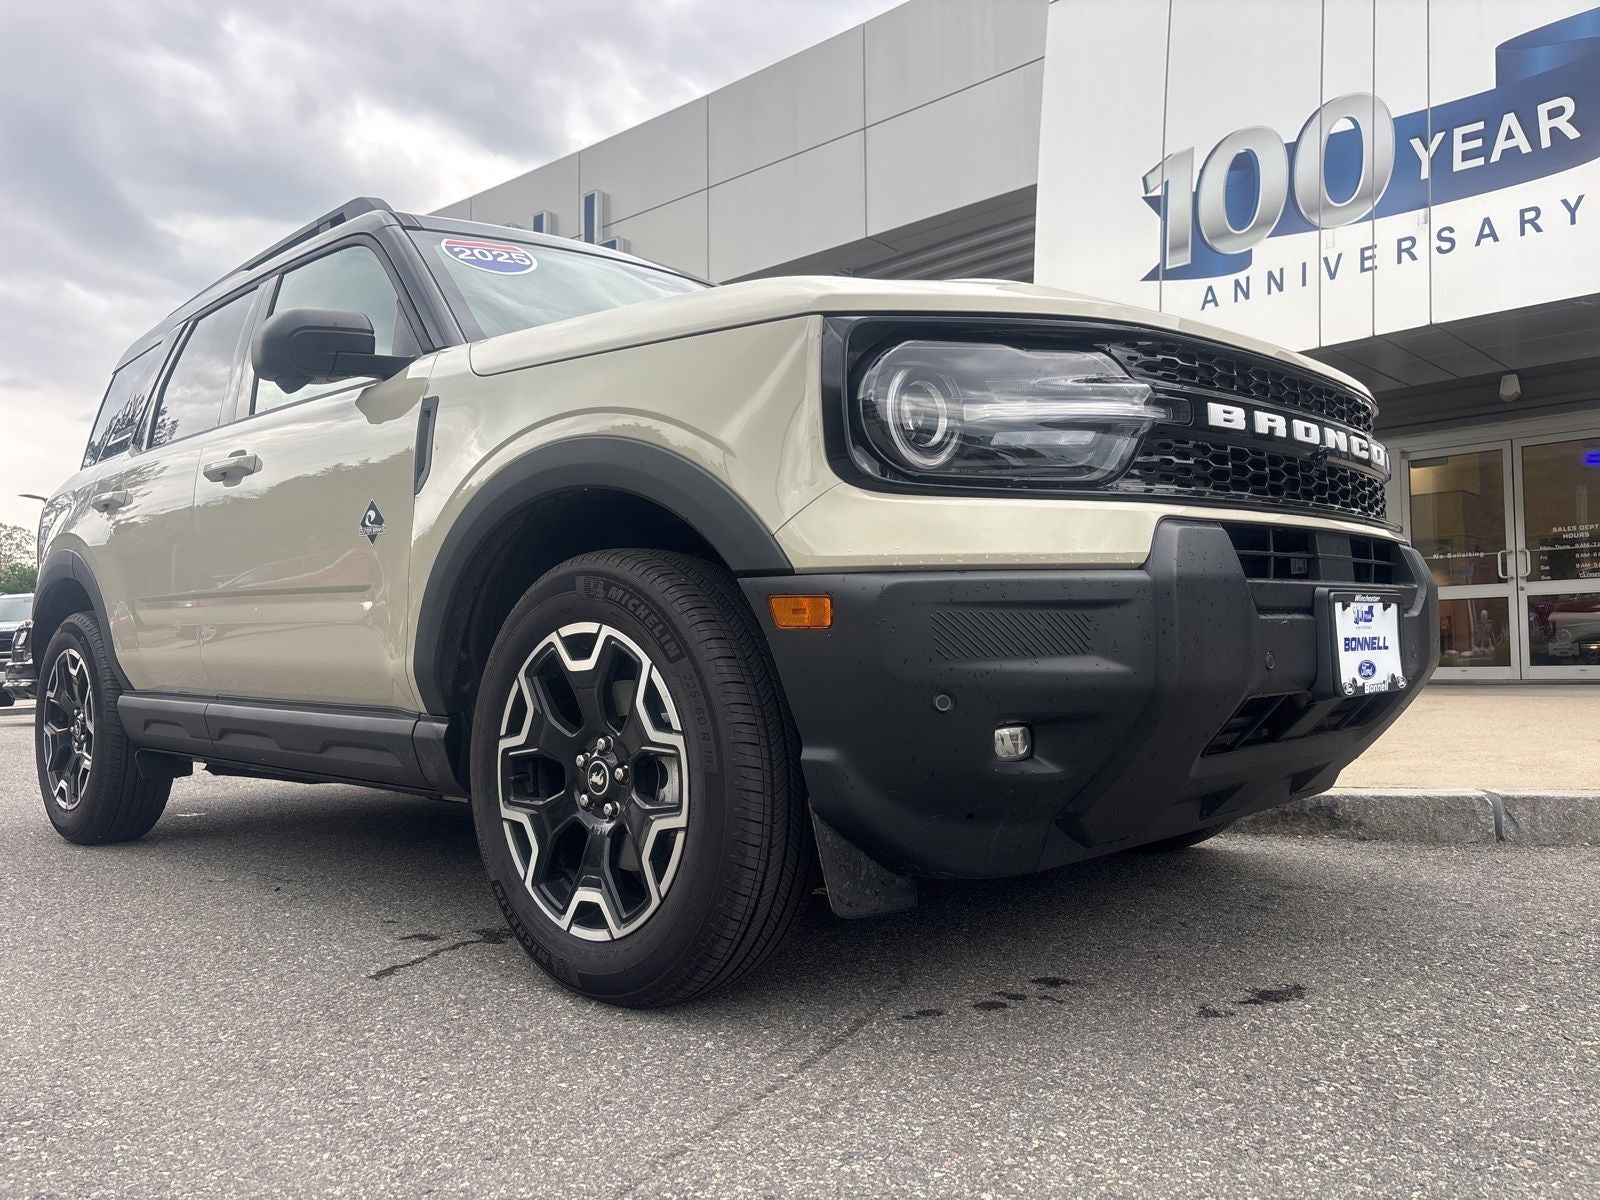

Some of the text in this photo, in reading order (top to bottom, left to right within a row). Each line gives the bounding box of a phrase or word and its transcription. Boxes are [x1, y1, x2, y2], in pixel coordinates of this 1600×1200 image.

[1141, 92, 1581, 270] 100 YEAR
[453, 247, 532, 265] 2025
[1201, 194, 1586, 311] ANNIVERSARY
[1207, 402, 1388, 467] BRONCO
[607, 586, 681, 659] MICHELIN
[1343, 636, 1389, 652] BONNELL
[1364, 680, 1389, 693] Bonnell
